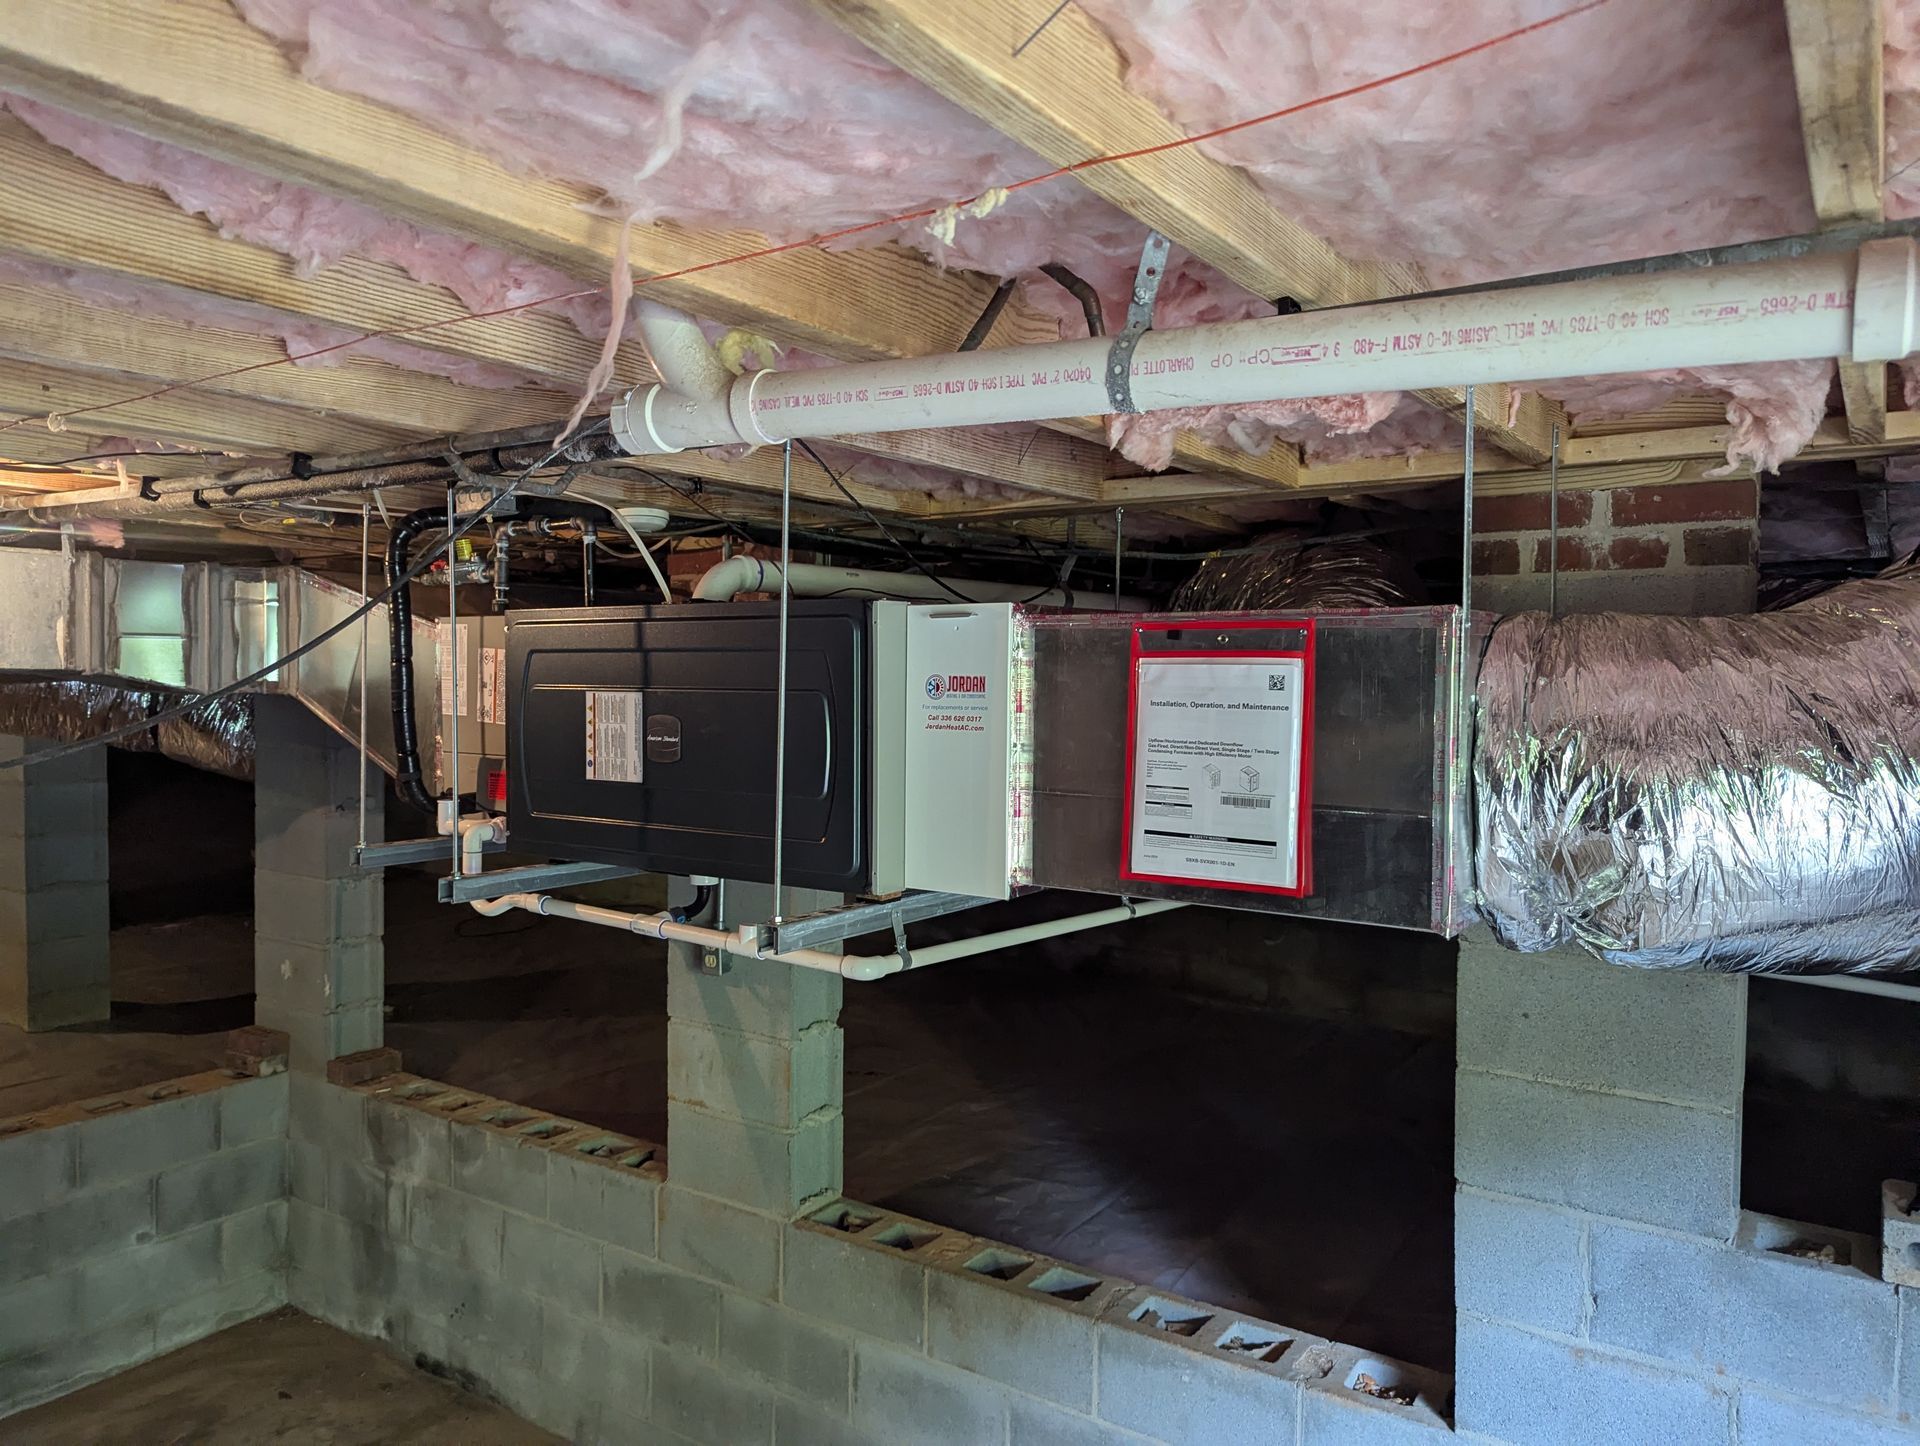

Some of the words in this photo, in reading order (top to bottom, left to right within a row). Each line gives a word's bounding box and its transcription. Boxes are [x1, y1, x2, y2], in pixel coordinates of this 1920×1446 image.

[1825, 291, 1854, 309] STM
[1645, 307, 1670, 327] SCH
[1504, 322, 1535, 339] WELL
[1353, 337, 1388, 355] F-480
[1393, 333, 1422, 351] ASTM
[1131, 363, 1139, 377] PI
[1143, 357, 1194, 376] CHARLOTTE
[968, 379, 979, 392] 40
[981, 376, 997, 390] SCH
[1006, 374, 1025, 389] TYPE
[1032, 371, 1047, 386] PVC
[913, 382, 942, 398] D-2665
[945, 380, 965, 393] ASTM
[802, 394, 815, 407] PVC
[817, 392, 841, 406] D-1785
[844, 391, 853, 404] 40
[855, 389, 869, 402] SCH
[947, 676, 986, 693] JORDAN
[1150, 699, 1188, 709] Installation,
[1190, 701, 1226, 710] Operation,
[1227, 702, 1241, 710] and
[1242, 702, 1290, 711] Maintenance
[925, 723, 985, 731] JordanHeatAC.com
